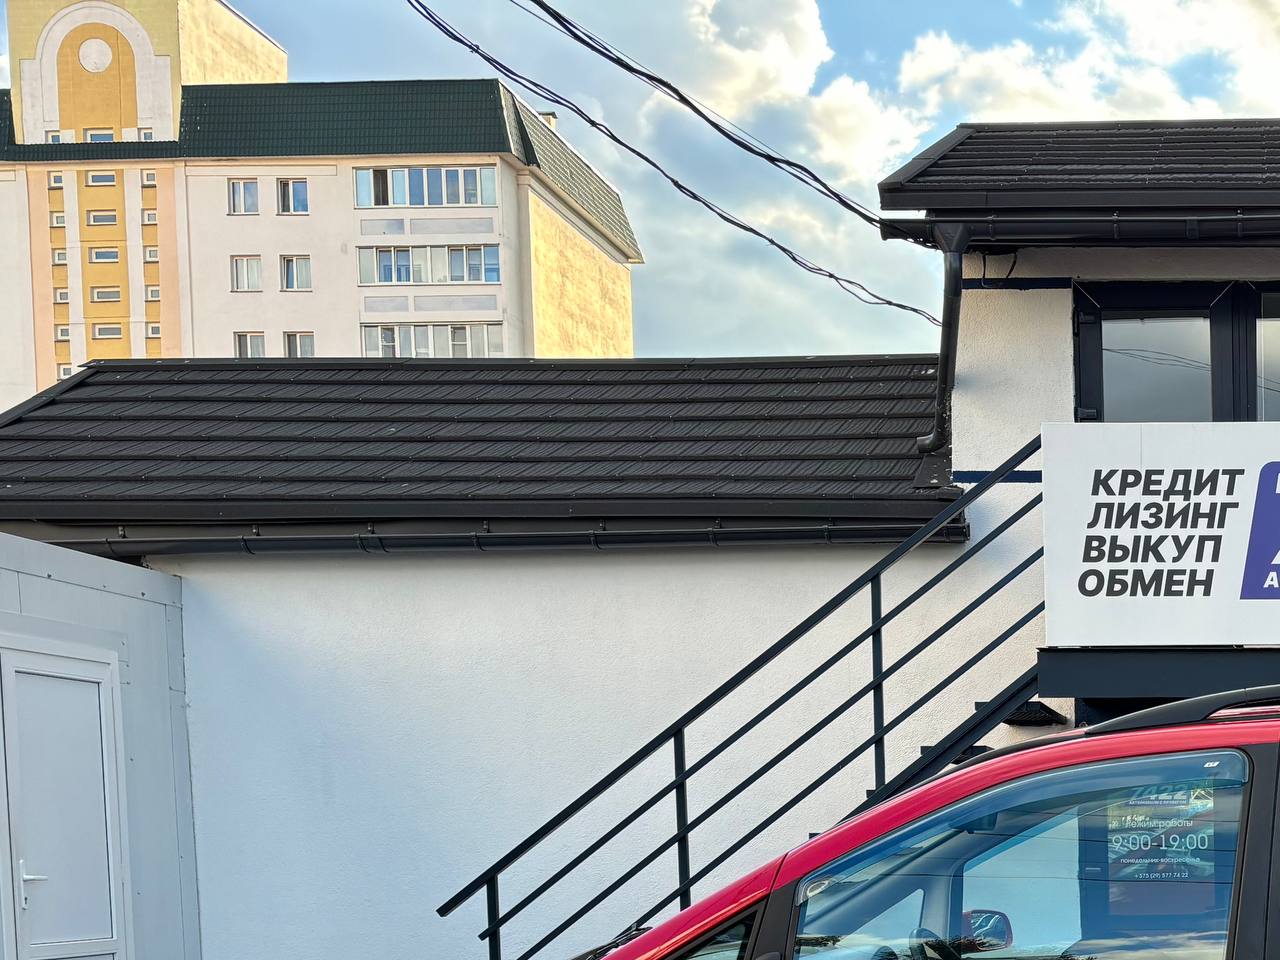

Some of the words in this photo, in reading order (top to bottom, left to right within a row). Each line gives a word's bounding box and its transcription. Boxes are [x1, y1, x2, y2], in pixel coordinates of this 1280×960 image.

[1091, 469, 1245, 501] КРЕДИТ
[1087, 502, 1239, 529] ЛИЗИНГ
[1083, 535, 1222, 562] ВЫКУП
[1078, 568, 1214, 597] ОБМЕН
[1112, 833, 1208, 851] 9:00-19:00
